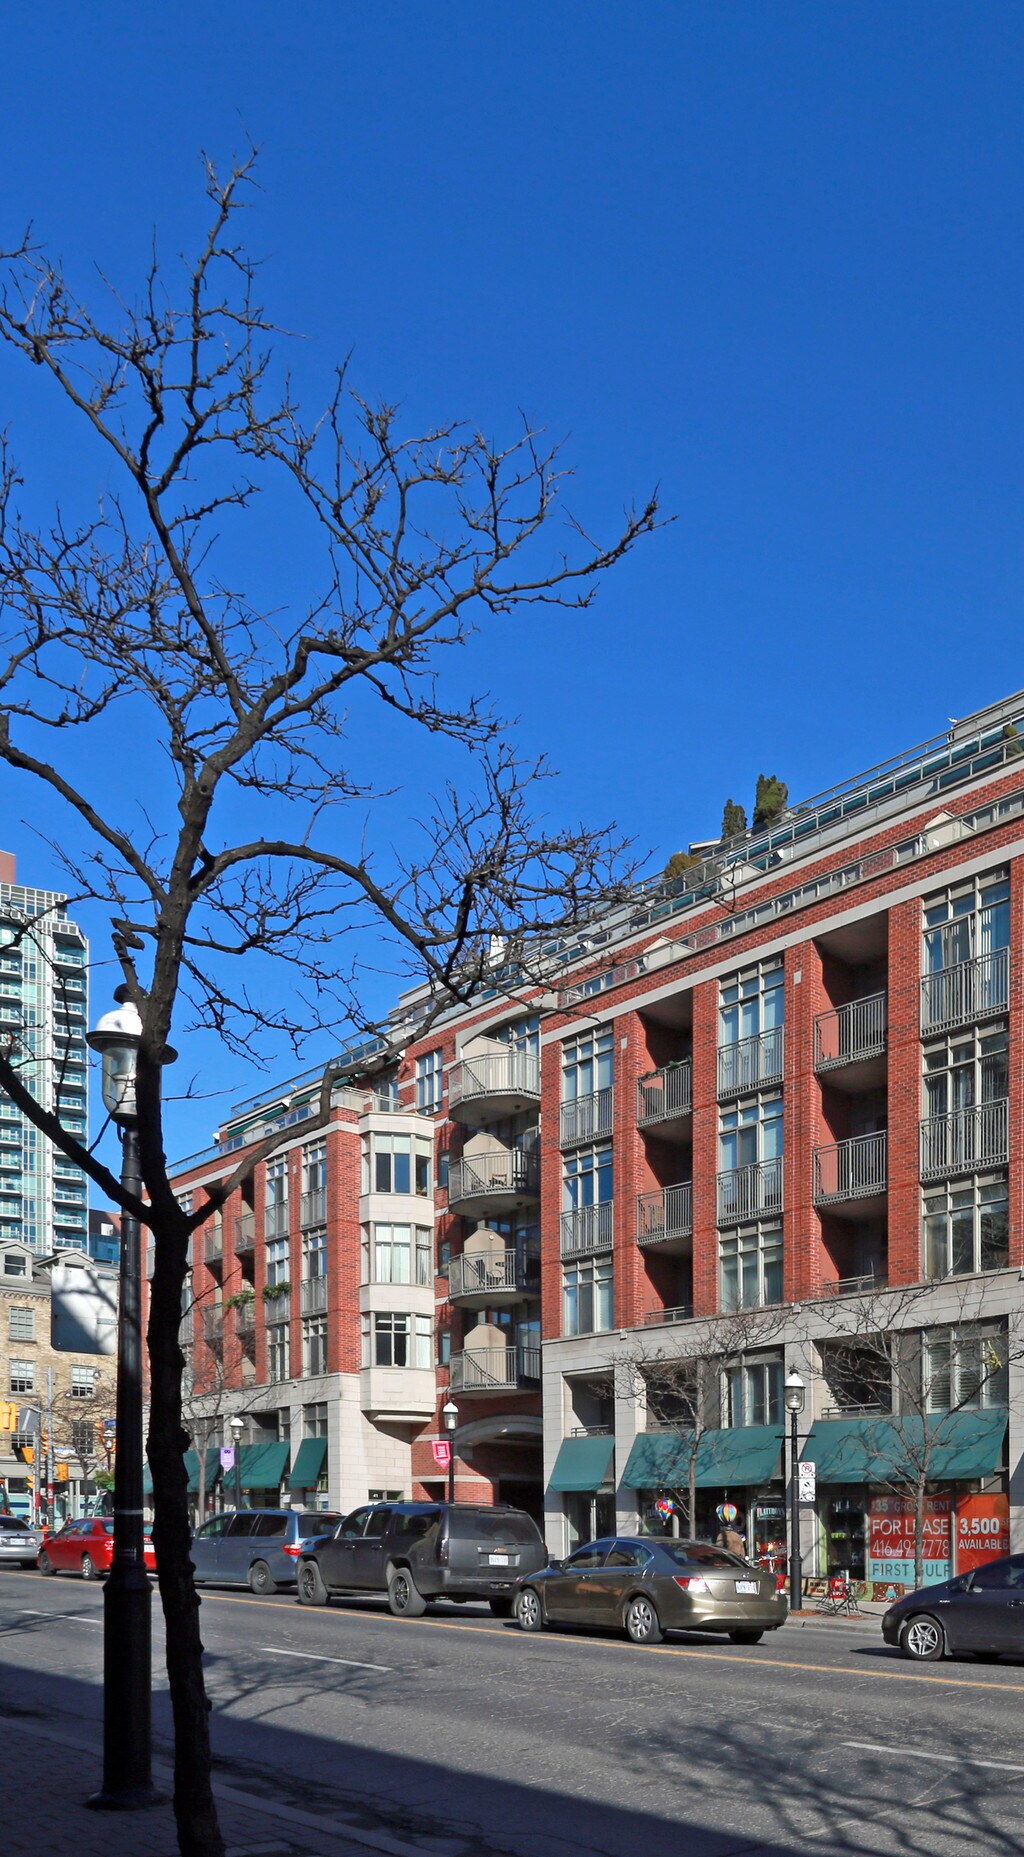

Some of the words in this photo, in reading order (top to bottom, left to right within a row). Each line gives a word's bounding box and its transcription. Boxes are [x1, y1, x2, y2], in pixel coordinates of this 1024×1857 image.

[927, 1500, 950, 1511] RENT
[872, 1519, 902, 1535] FOR
[960, 1517, 1000, 1536] 3,500
[958, 1539, 1009, 1550] AVAILABLE
[872, 1564, 909, 1576] FIRST
[921, 1564, 950, 1576] ULF
